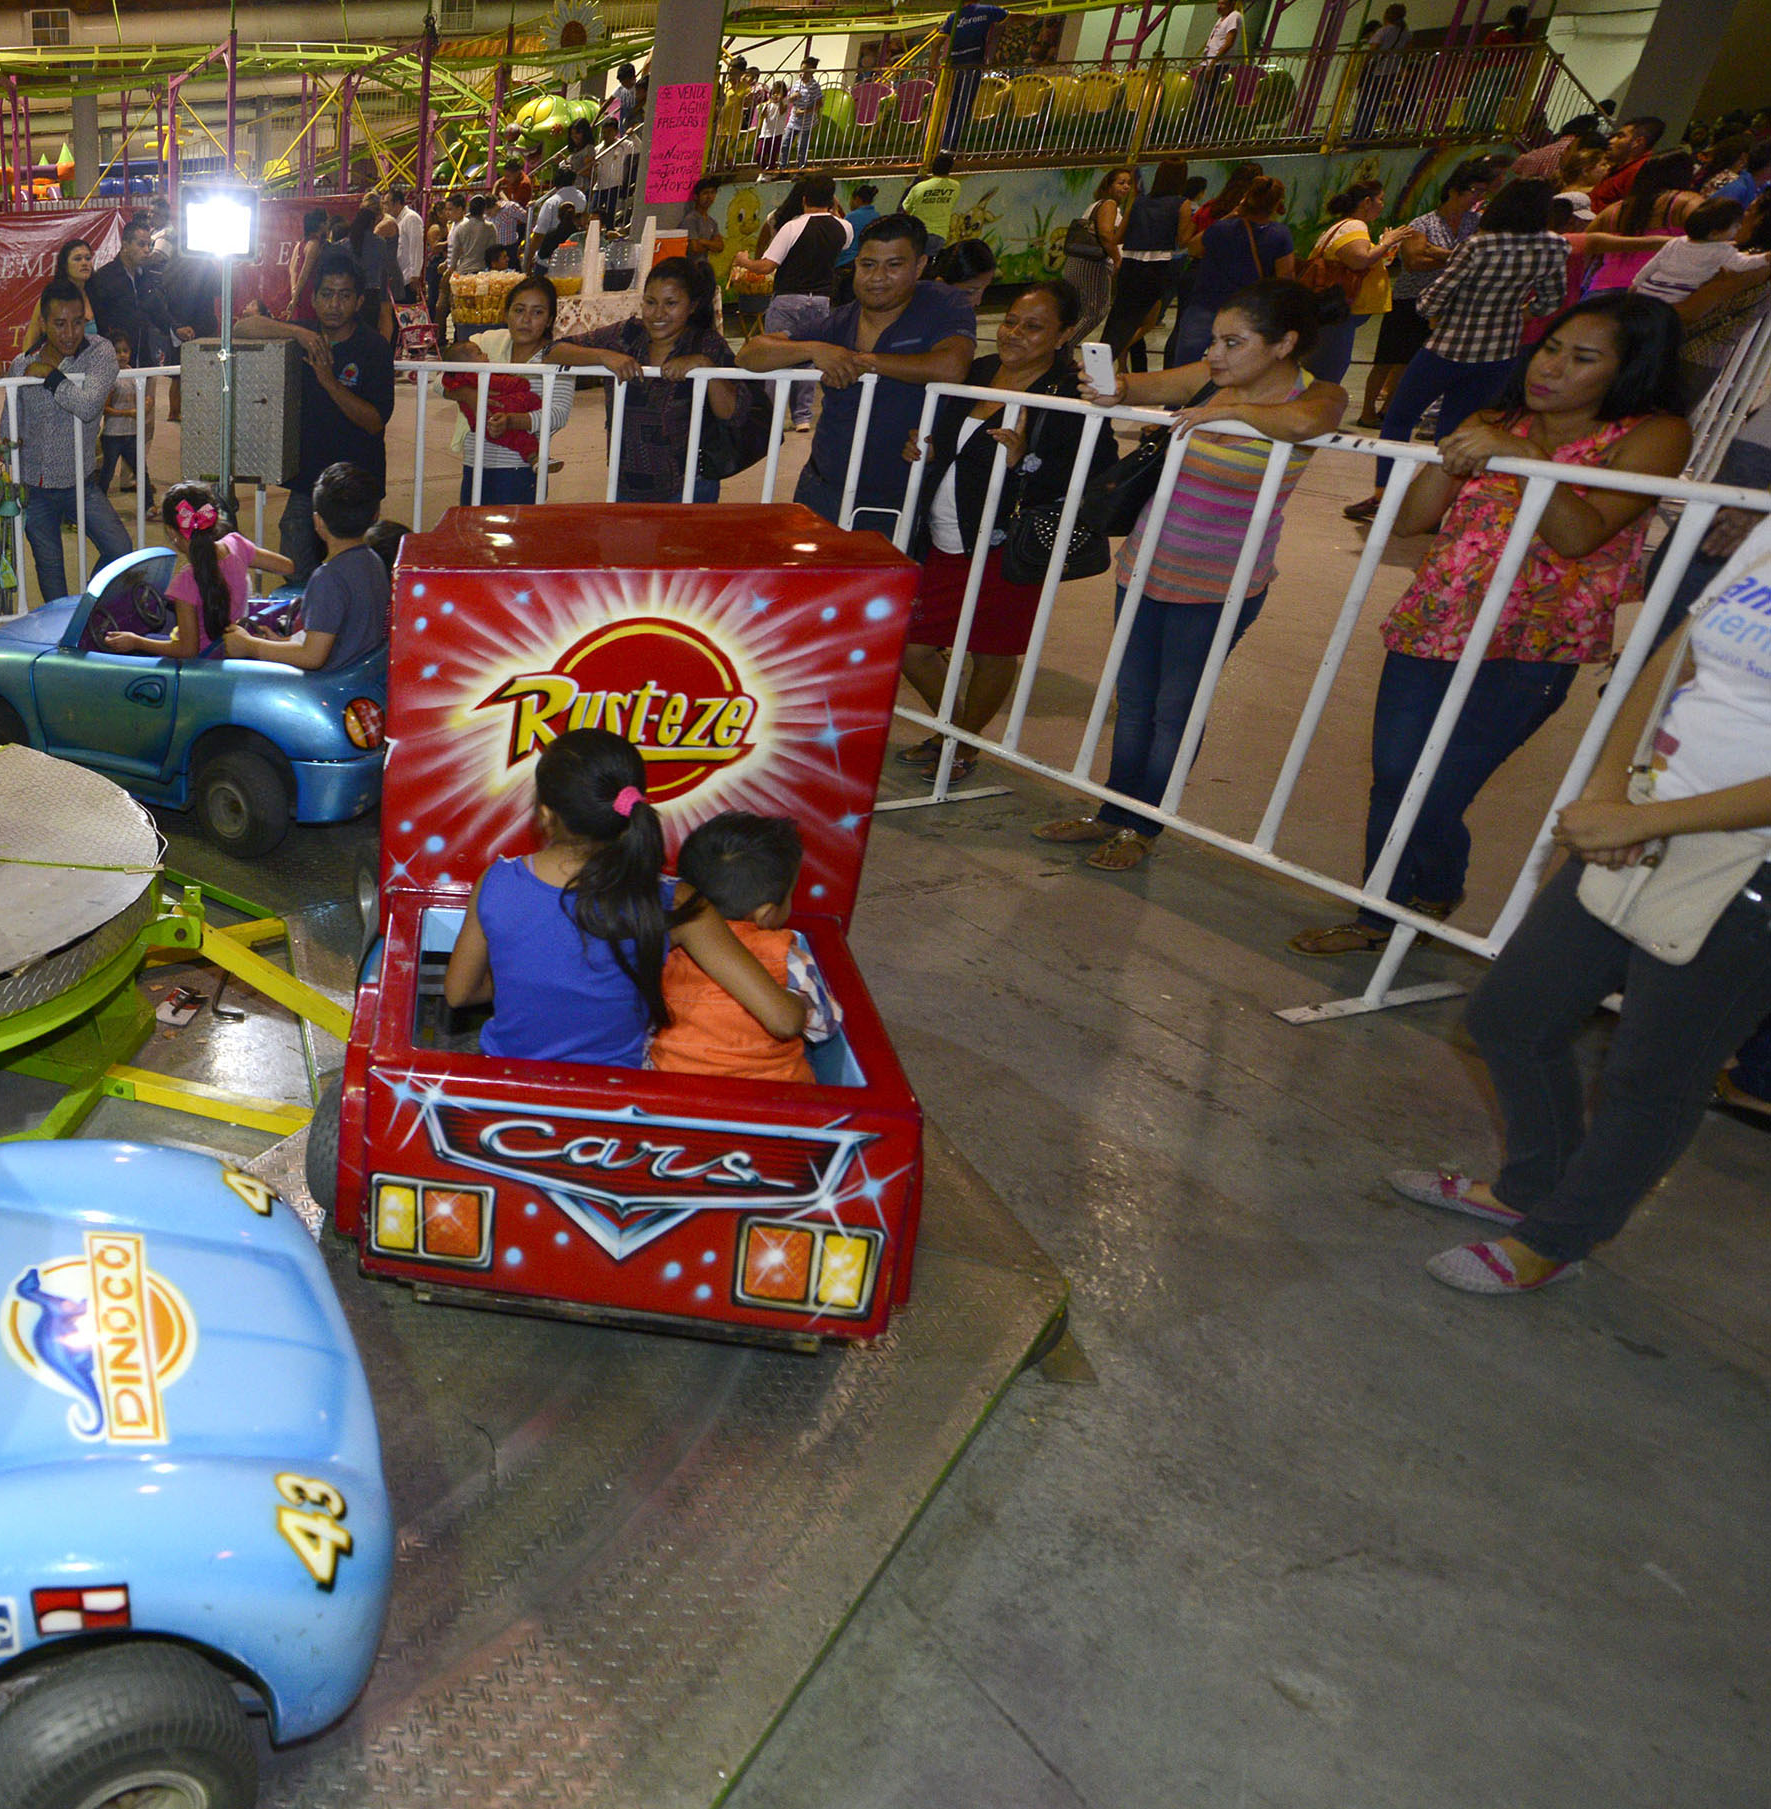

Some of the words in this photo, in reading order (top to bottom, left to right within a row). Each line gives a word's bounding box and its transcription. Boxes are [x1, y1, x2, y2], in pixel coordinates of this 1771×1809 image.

[479, 1119, 796, 1188] Cars
[95, 1245, 148, 1427] DINOCO
[273, 1471, 353, 1594] 43
